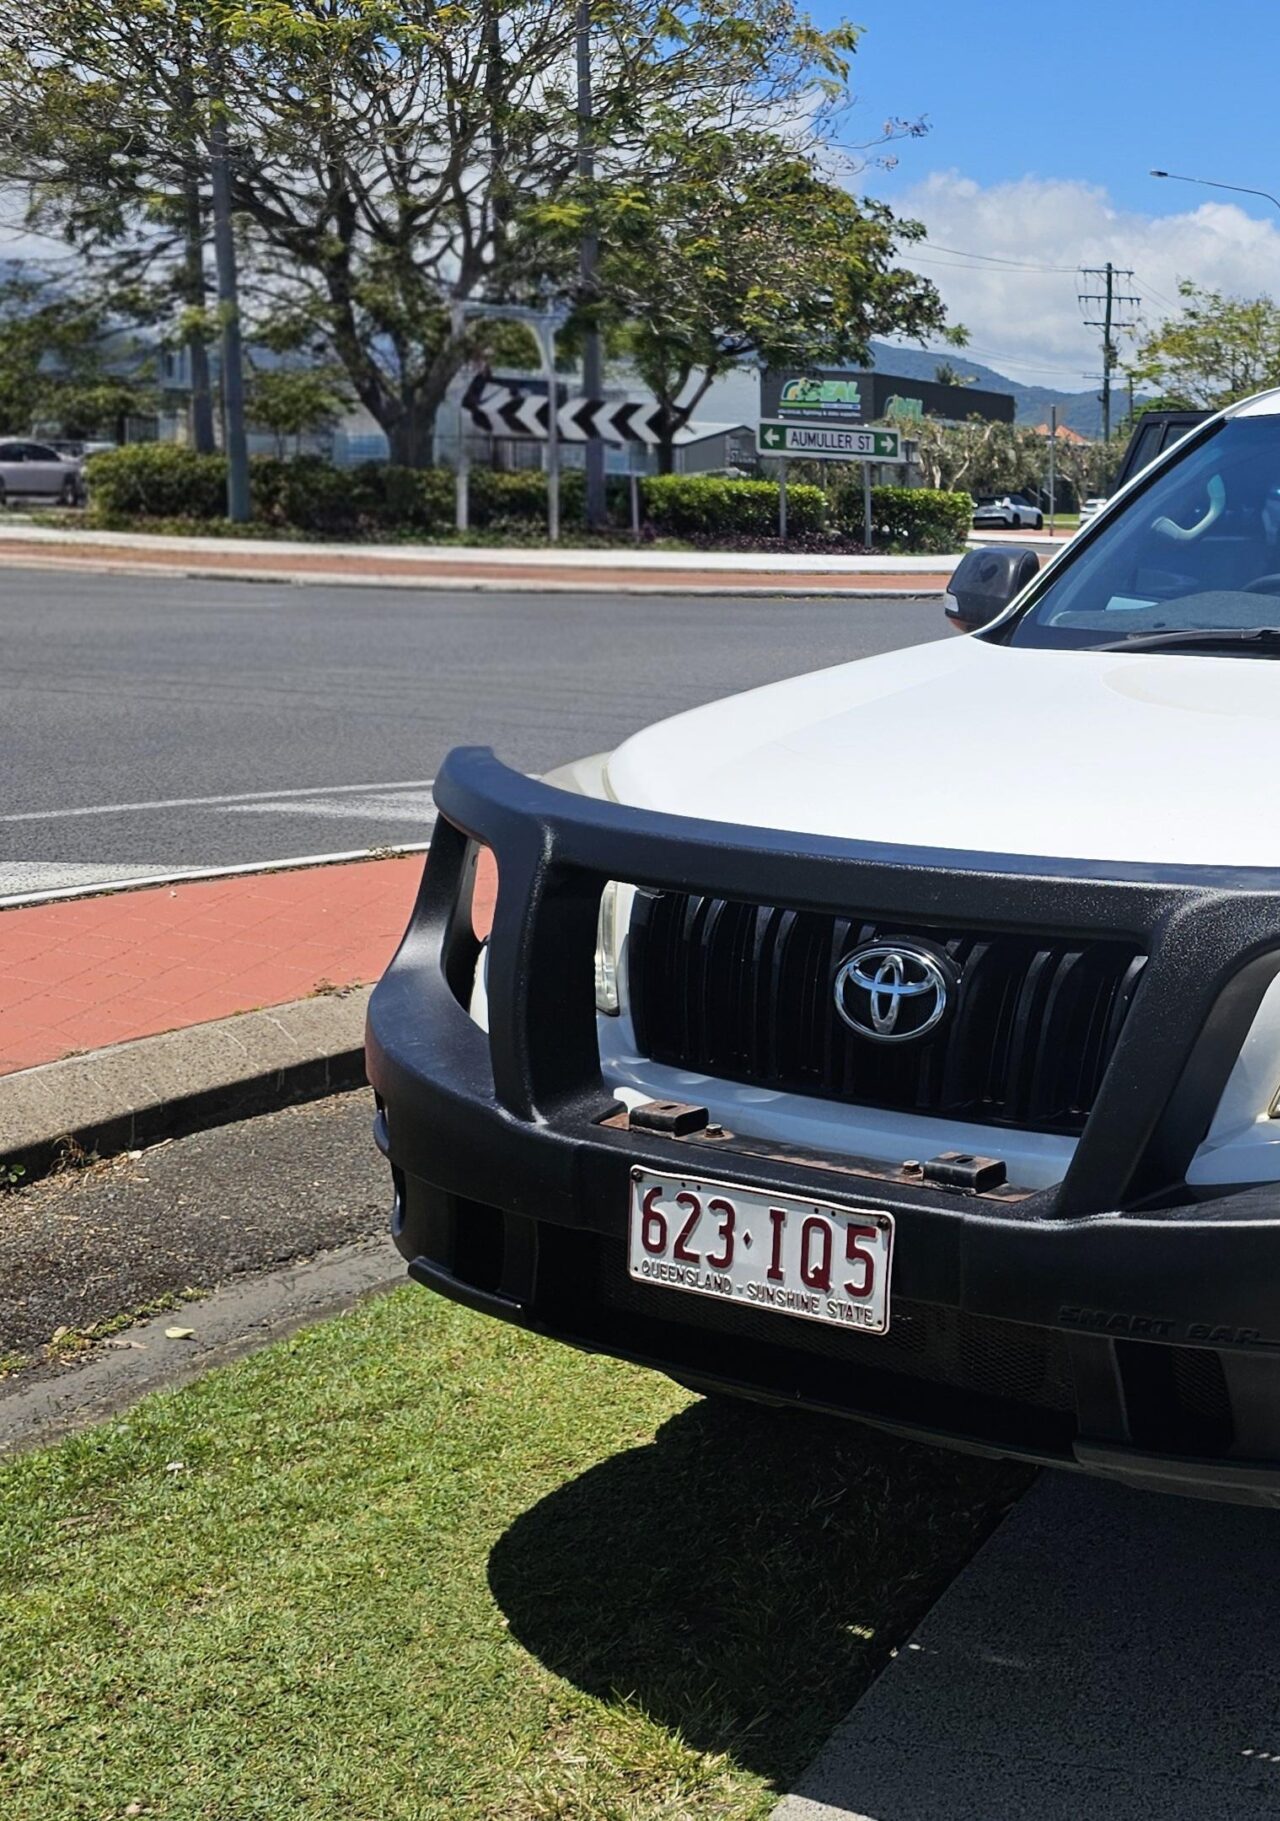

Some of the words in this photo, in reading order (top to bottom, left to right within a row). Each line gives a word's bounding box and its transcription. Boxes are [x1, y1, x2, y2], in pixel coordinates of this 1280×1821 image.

[791, 431, 853, 450] AUMULLER
[857, 436, 872, 451] ST
[640, 1259, 733, 1295] QUEENSLAND
[745, 1280, 821, 1316] SUNSHINE
[826, 1299, 876, 1327] STATE
[1057, 1305, 1177, 1338] SMART
[1184, 1322, 1262, 1345] BAR
